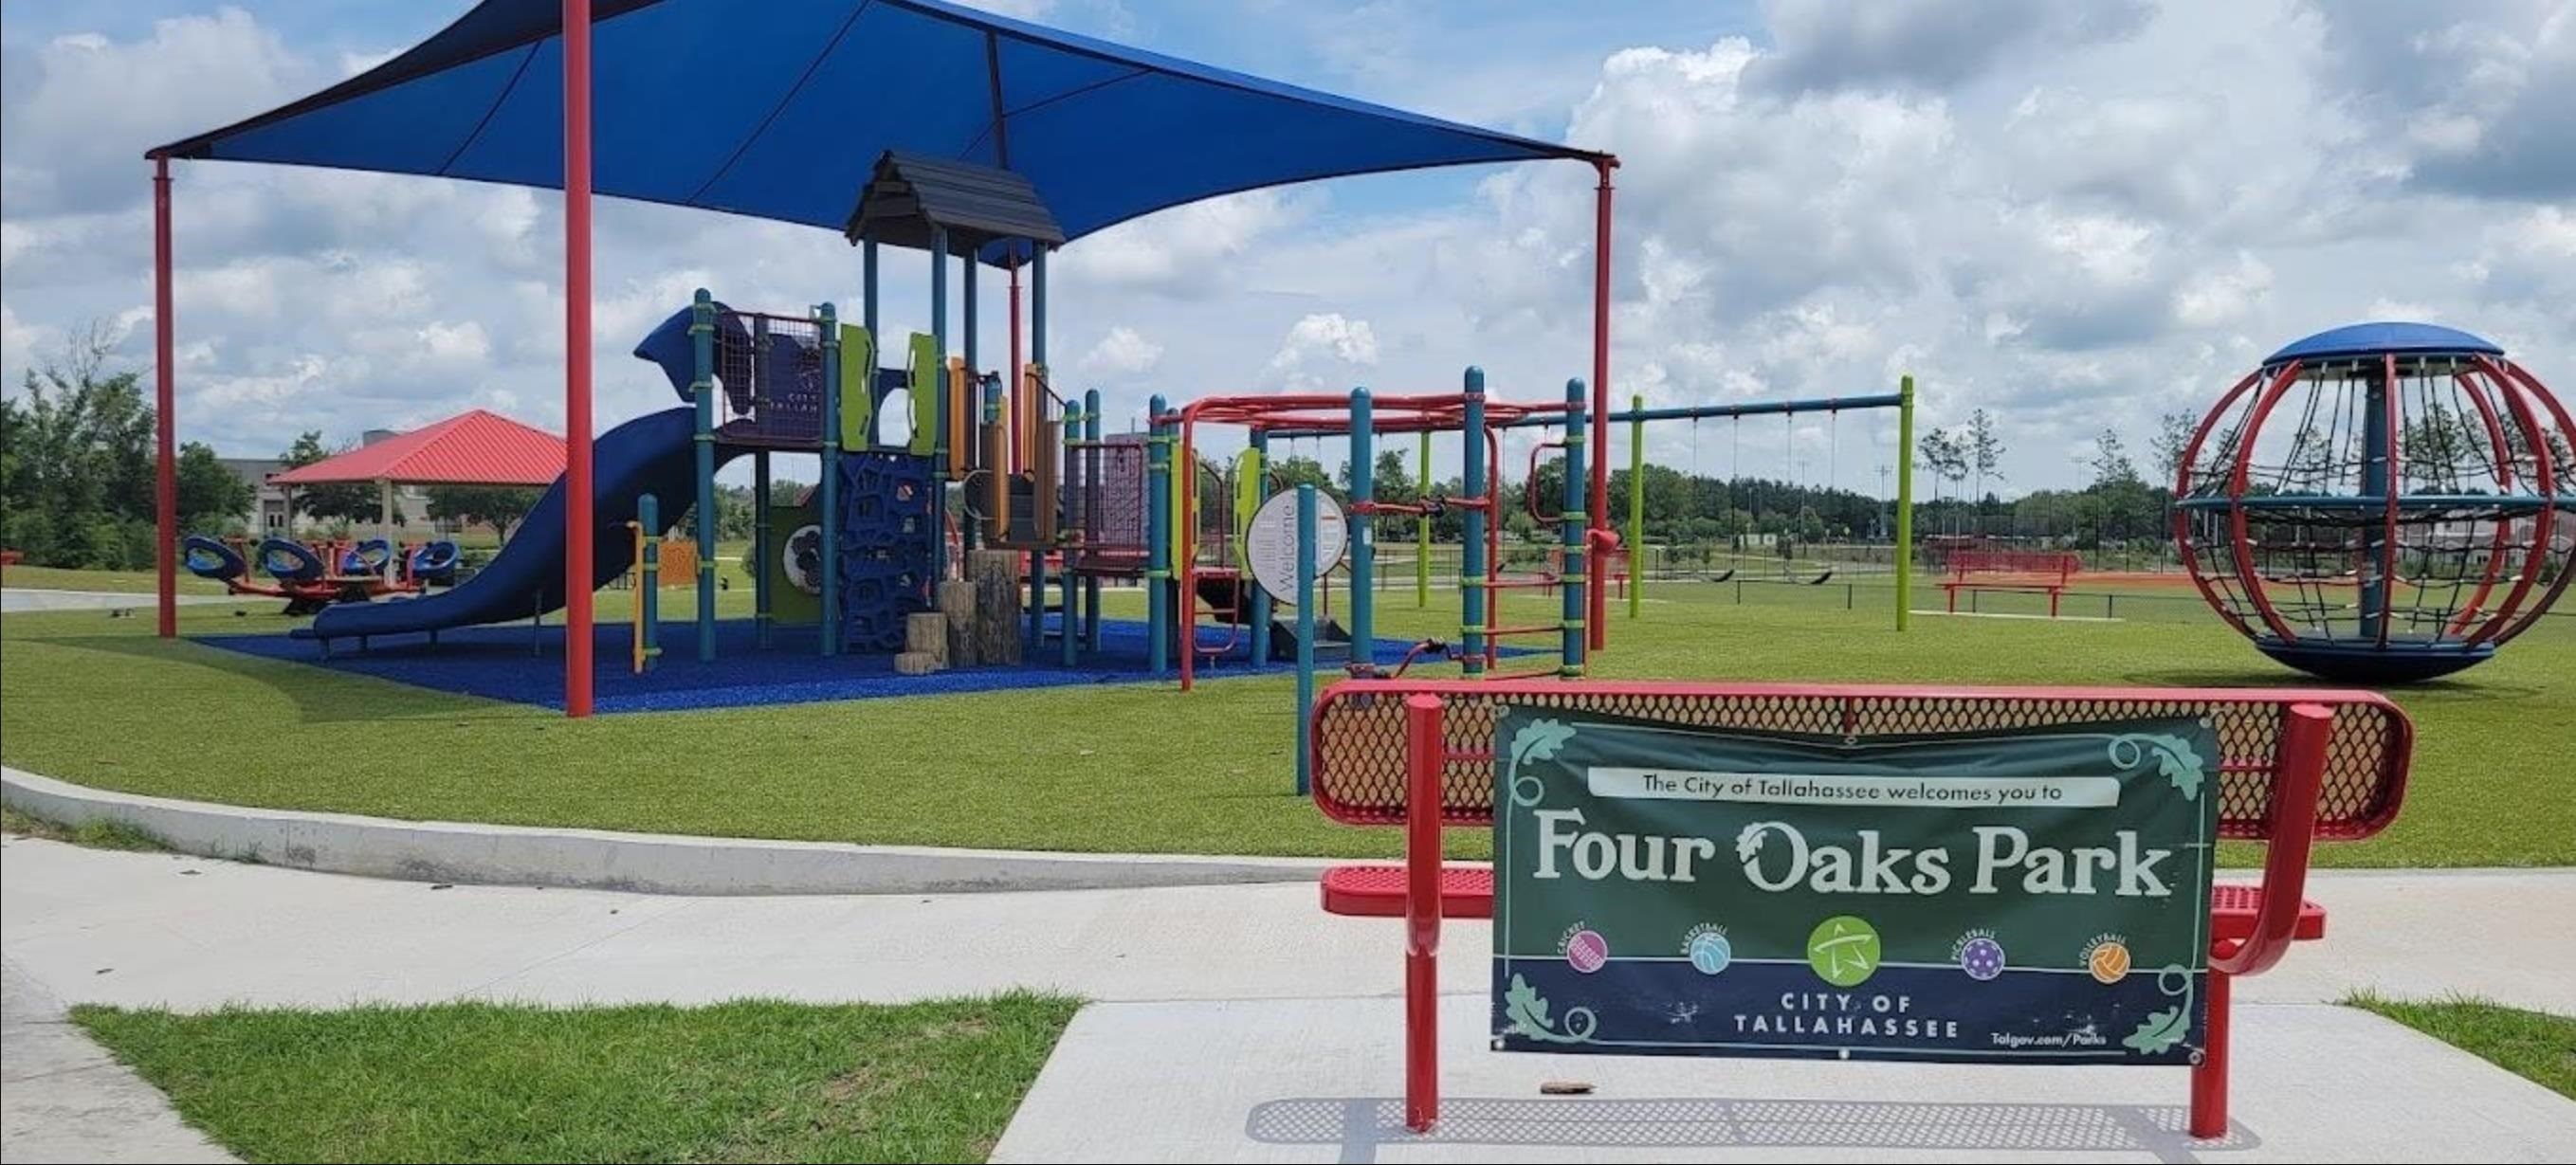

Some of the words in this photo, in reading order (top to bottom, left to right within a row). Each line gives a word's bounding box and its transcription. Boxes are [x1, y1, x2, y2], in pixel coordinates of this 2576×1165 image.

[1279, 504, 1295, 592] Welcome
[1643, 774, 1677, 792] The
[1684, 776, 1725, 798] City
[1731, 778, 1752, 795] of
[1759, 779, 1880, 799] Tallahassee
[1887, 782, 1992, 801] welcomes
[1998, 788, 2037, 805] you
[2042, 784, 2062, 800] to
[1532, 808, 1716, 883] Four
[1735, 821, 1951, 896] Oaks
[1968, 826, 2172, 897] Park
[1557, 920, 1585, 955] CRICKET
[1680, 922, 1727, 955] BASKETBALL
[1950, 928, 1995, 960] PICKLEBALL
[2078, 932, 2127, 967] VOLLEYBALL
[1781, 992, 1852, 1011] CITY
[1872, 995, 1911, 1013] OF
[1734, 1014, 1958, 1038] TALLAHASSEE
[1990, 1032, 2107, 1048] Talgov.com/Parks
